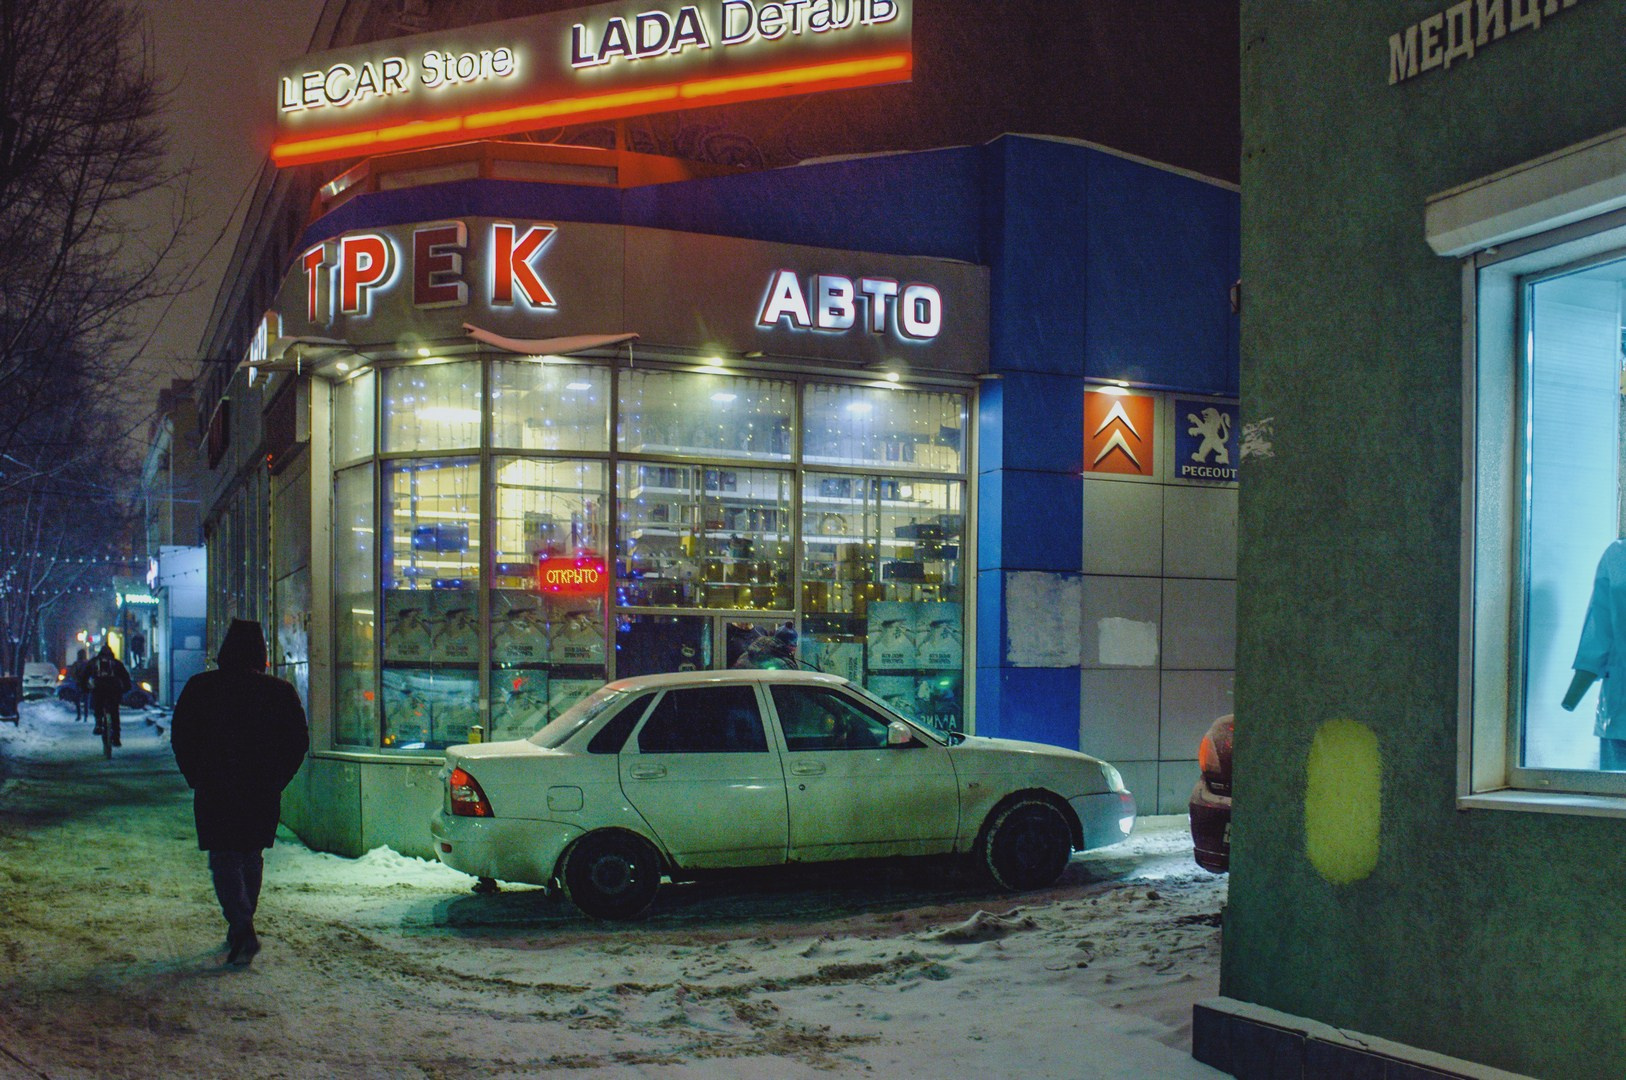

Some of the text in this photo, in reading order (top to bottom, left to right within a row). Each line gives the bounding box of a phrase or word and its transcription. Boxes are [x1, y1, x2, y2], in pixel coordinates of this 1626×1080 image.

[571, 5, 711, 69] LADA
[1388, 0, 1578, 86] МЕДИЦ
[281, 47, 516, 113] LECAR Store
[303, 221, 942, 341] ТРЕК АВТО
[1182, 465, 1238, 479] PEGEOUT
[546, 568, 599, 584] ОТКРЫТО
